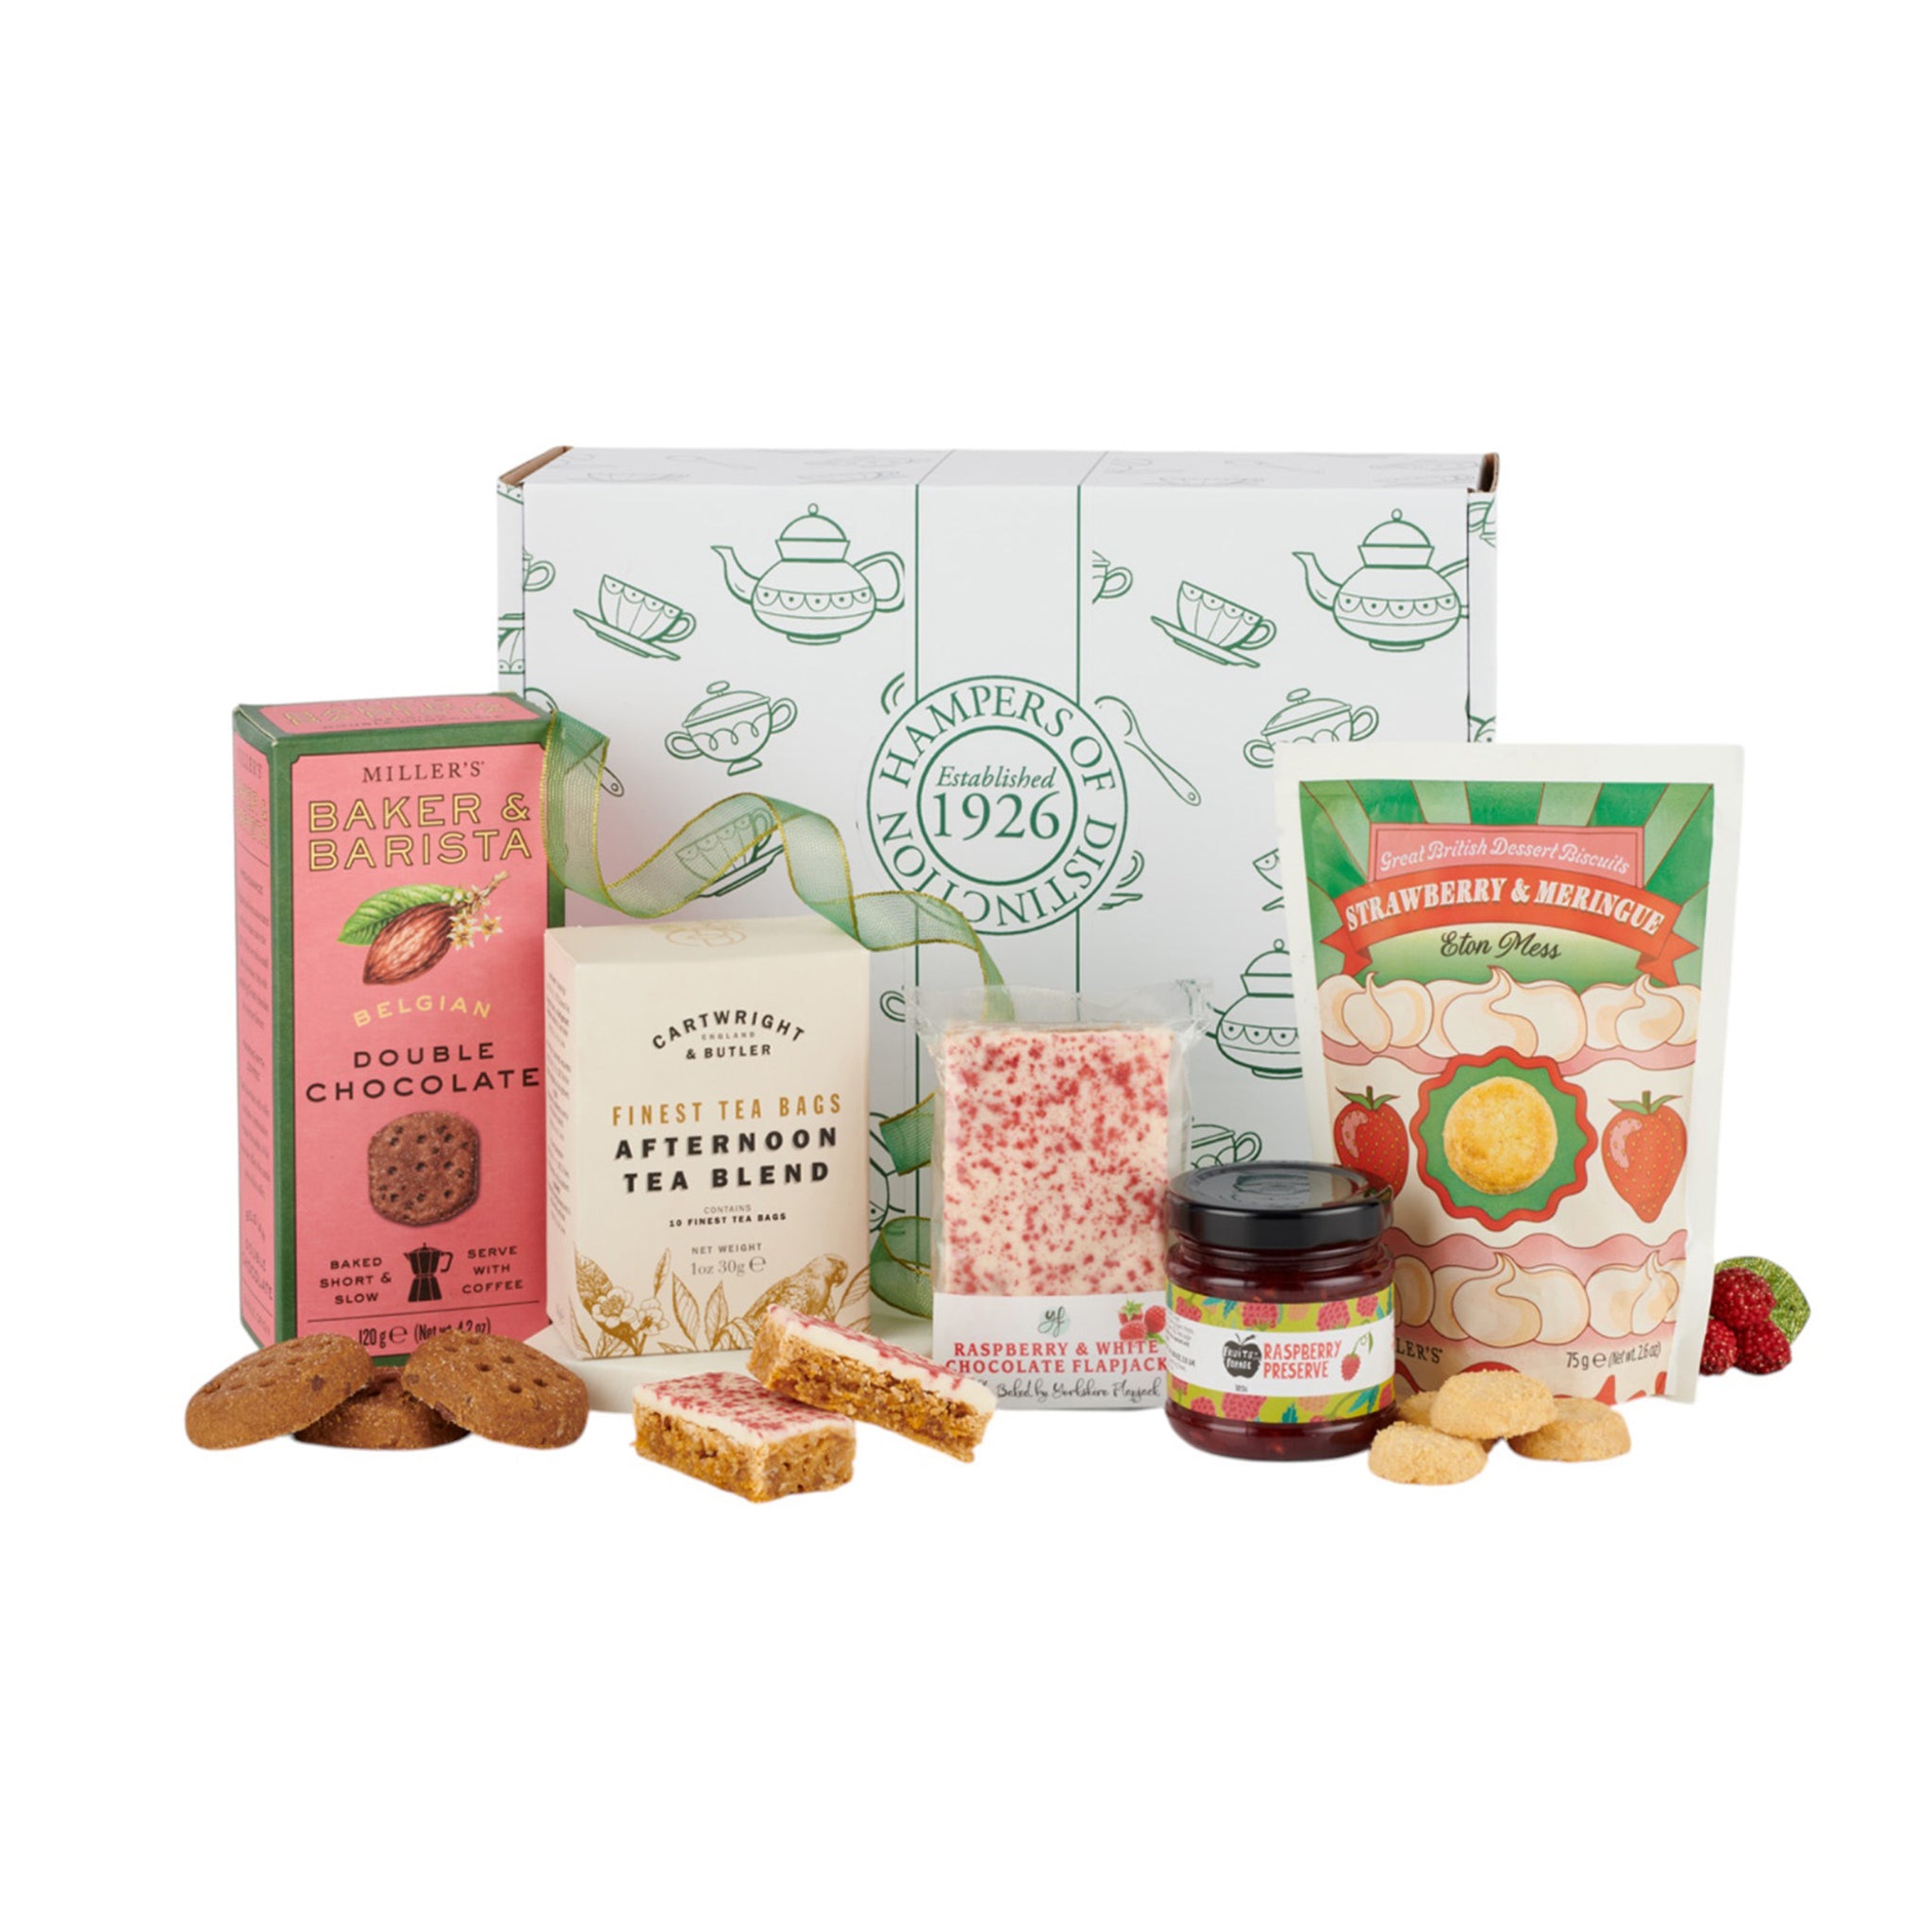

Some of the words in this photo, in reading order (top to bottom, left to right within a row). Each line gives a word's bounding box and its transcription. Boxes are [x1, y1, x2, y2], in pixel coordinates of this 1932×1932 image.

[878, 685, 1074, 789] HAMPERS
[362, 761, 483, 783] MILLER'S
[1070, 736, 1116, 791] OF
[936, 765, 1057, 789] Established
[308, 792, 482, 833] BAKER
[501, 793, 530, 821] &
[933, 791, 1060, 841] 1926
[308, 828, 532, 872] BARISTA
[1381, 850, 1424, 872] Great
[1427, 836, 1488, 861] British
[1490, 837, 1559, 860] Dessert
[1561, 843, 1630, 874] Biscuits
[877, 811, 1117, 926] DISTINCTION
[1345, 877, 1507, 931] STRAWBERRY
[1510, 878, 1530, 904] &
[1533, 880, 1665, 936] MERINGUE
[1441, 931, 1491, 958] Eton
[1497, 932, 1562, 959] Mess
[354, 995, 491, 1027] BELGIAN
[653, 1010, 805, 1050] CARTWRIGHT
[701, 1031, 755, 1041] ENGLAND
[354, 1042, 494, 1068] DOUBLE
[686, 1048, 696, 1059] &
[705, 1044, 771, 1058] BUTLER
[306, 1068, 540, 1103] CHOCOLATE
[612, 1102, 703, 1126] FINEST
[719, 1098, 762, 1121] TEA
[779, 1093, 842, 1116] BAGS
[615, 1127, 837, 1160] AFTERNOON
[624, 1171, 689, 1192] TEA
[711, 1162, 830, 1189] BLEND
[688, 1217, 726, 1226] FINEST
[732, 1215, 752, 1224] TEA
[758, 1212, 787, 1222] BAGS
[704, 1205, 752, 1214] CONTAINS
[467, 1246, 518, 1258] SERVE
[691, 1246, 712, 1255] NET
[718, 1242, 762, 1254] WEIGHT
[330, 1257, 382, 1270] BAKED
[474, 1264, 510, 1275] WITH
[691, 1261, 714, 1275] 1oz
[718, 1259, 745, 1276] 30g
[320, 1275, 373, 1289] SHORT
[380, 1273, 391, 1284] &
[462, 1280, 524, 1294] COFFEE
[334, 1291, 379, 1305] SLOW
[954, 1342, 1069, 1357] RASPBERRY
[1075, 1341, 1089, 1355] &
[1096, 1340, 1159, 1355] WHITE
[1263, 1340, 1342, 1360] RASPBERRY
[946, 1358, 1066, 1374] CHOCOLATE
[1073, 1357, 1168, 1374] FLAPJACK
[1263, 1360, 1329, 1379] PRESERVE
[996, 1378, 1034, 1398] Baked
[1034, 1377, 1049, 1403] by
[1052, 1379, 1110, 1399] Yorkshire
[1113, 1376, 1161, 1403] Flapjack
